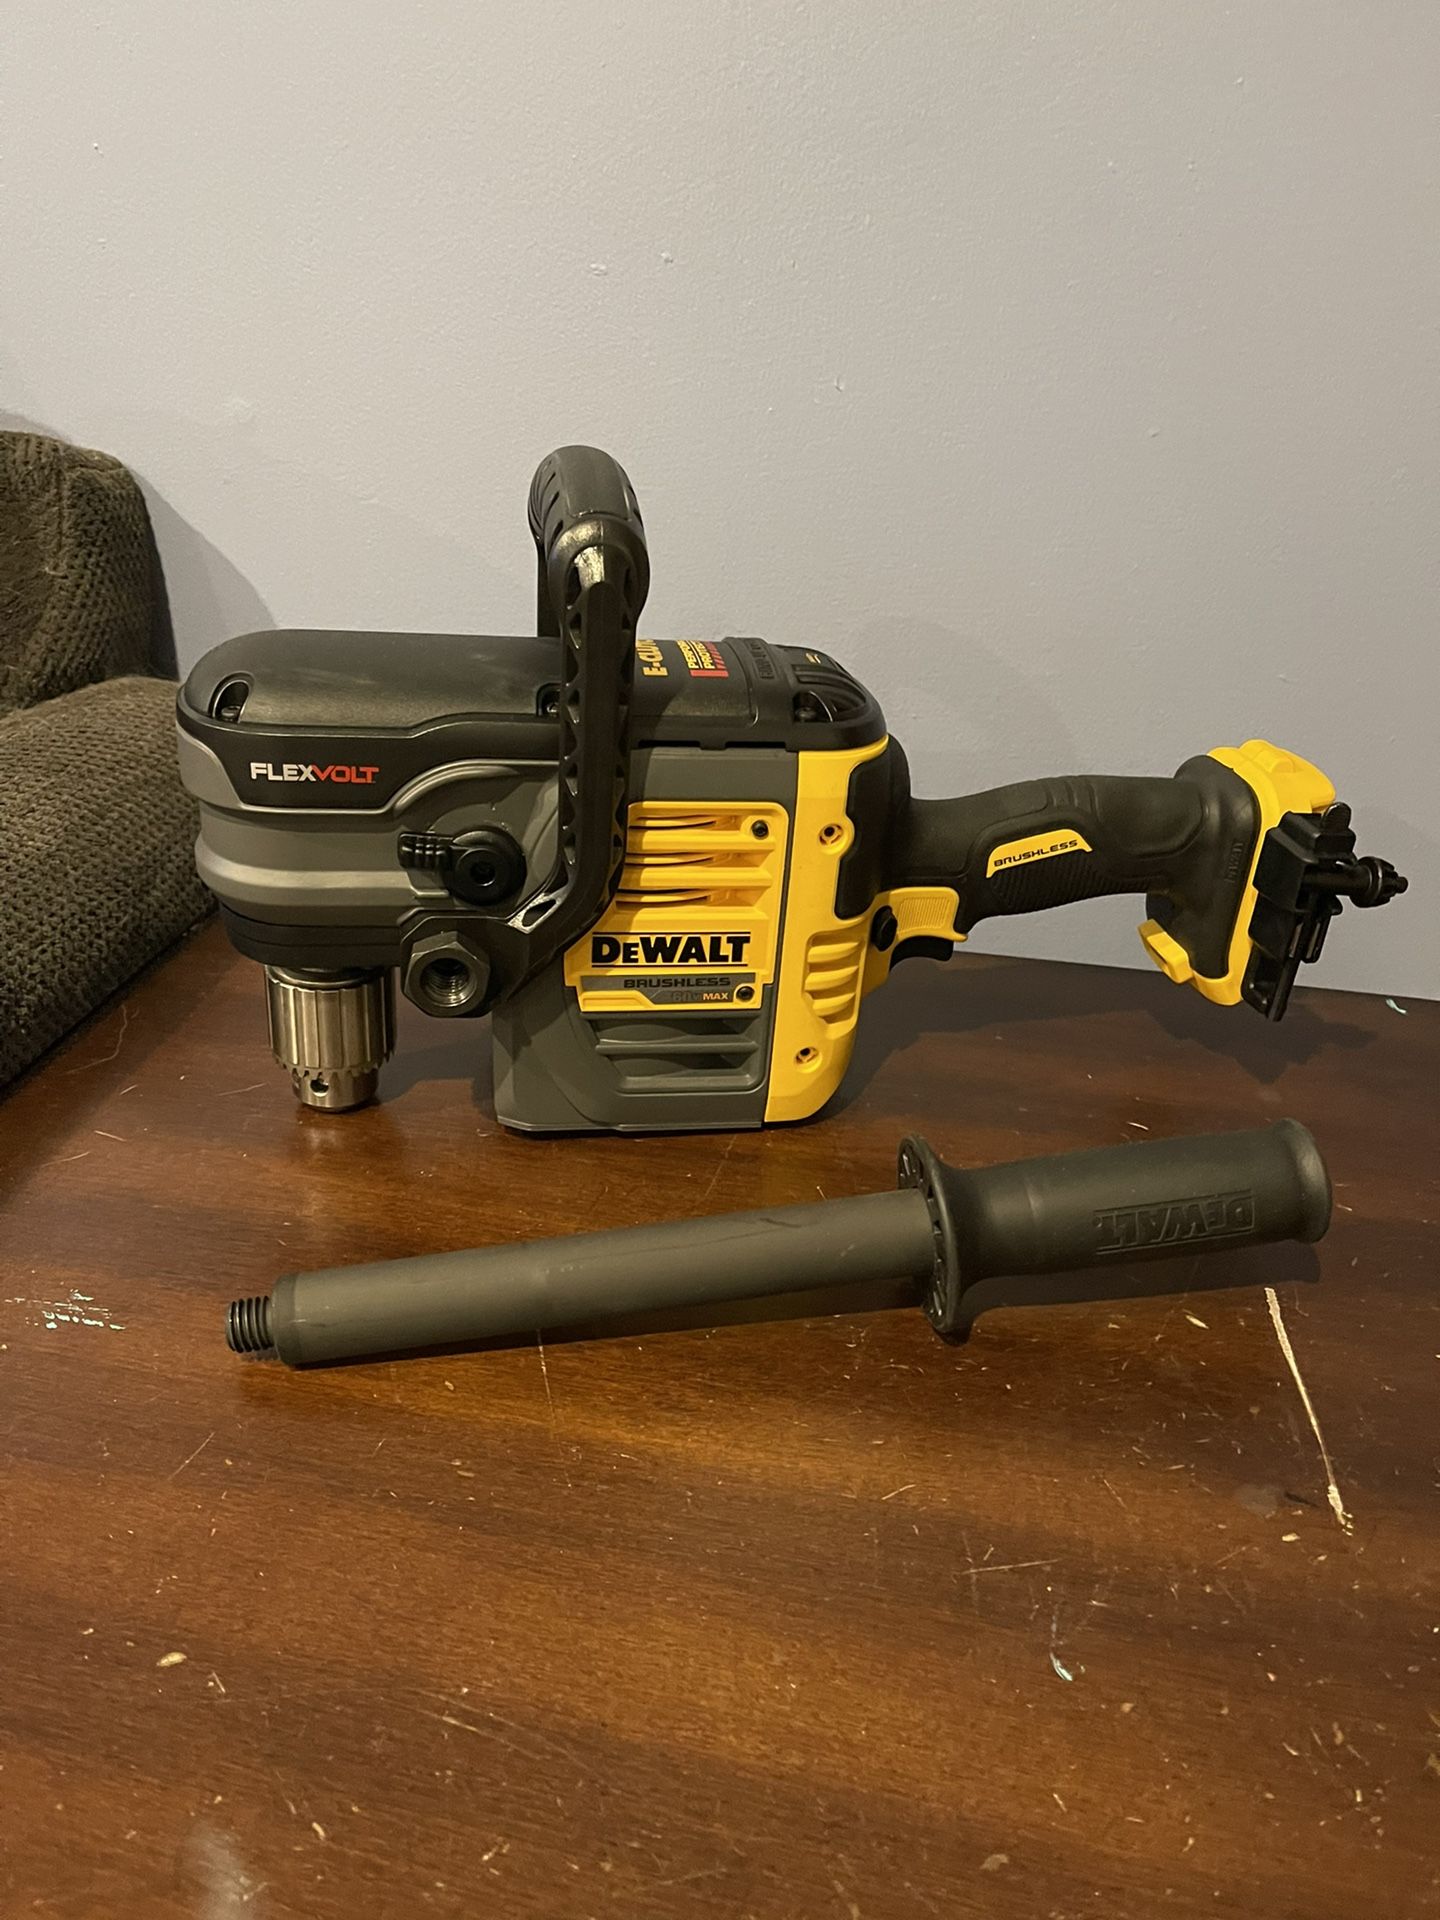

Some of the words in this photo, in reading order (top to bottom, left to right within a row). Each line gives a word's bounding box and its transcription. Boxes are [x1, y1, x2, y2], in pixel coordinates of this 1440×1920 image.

[250, 762, 379, 784] FLEXVOLT
[994, 840, 1078, 867] BRUSHLESS
[624, 977, 731, 988] BRUSHLESS
[703, 992, 729, 1001] MAX
